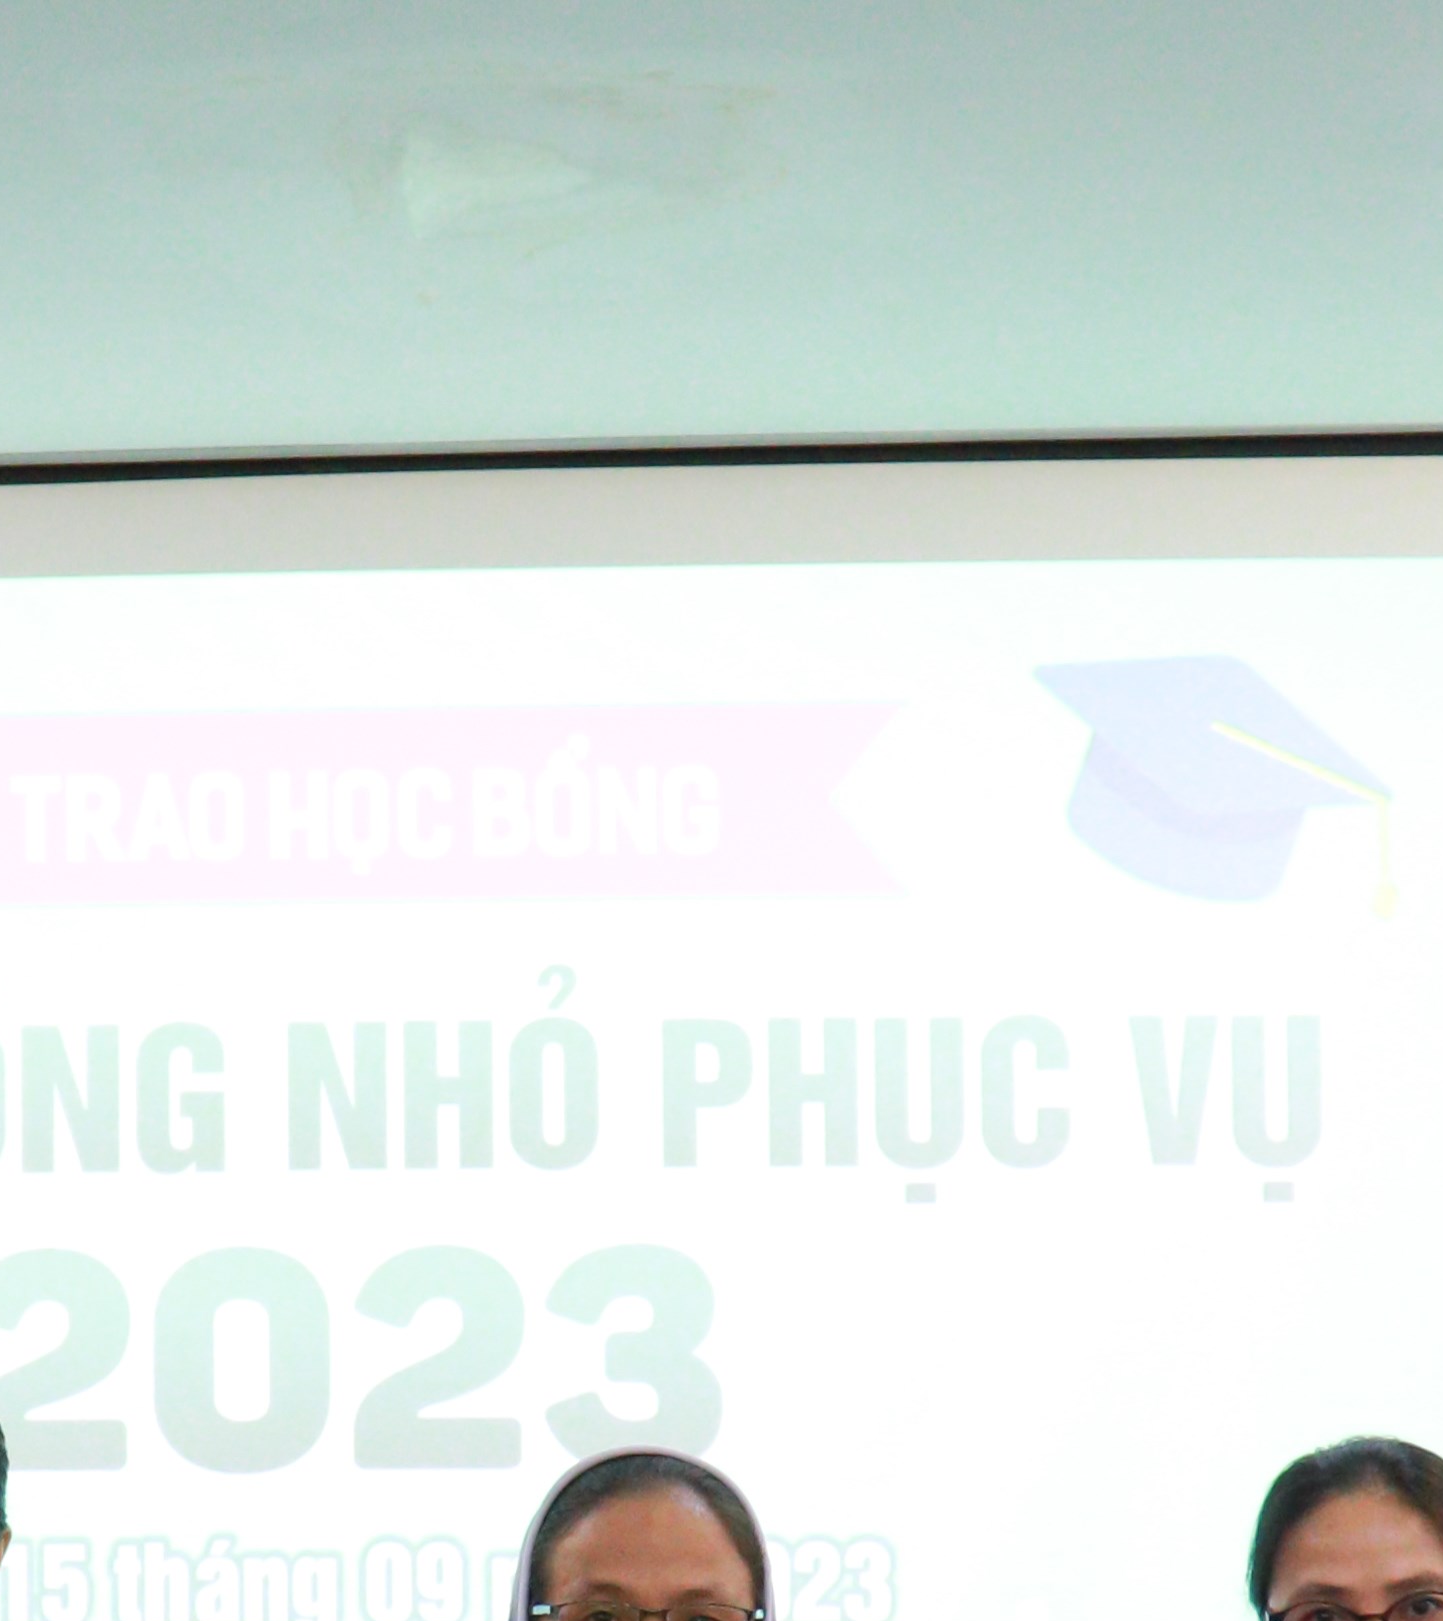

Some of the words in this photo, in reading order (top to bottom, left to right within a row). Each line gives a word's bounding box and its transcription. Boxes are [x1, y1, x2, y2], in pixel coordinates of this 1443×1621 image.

[8, 768, 246, 866] TRAO
[267, 763, 454, 877] HỌC
[286, 962, 600, 1172] NHỎ
[661, 1014, 1072, 1204] PHỤC
[1126, 1014, 1323, 1203] VỤ
